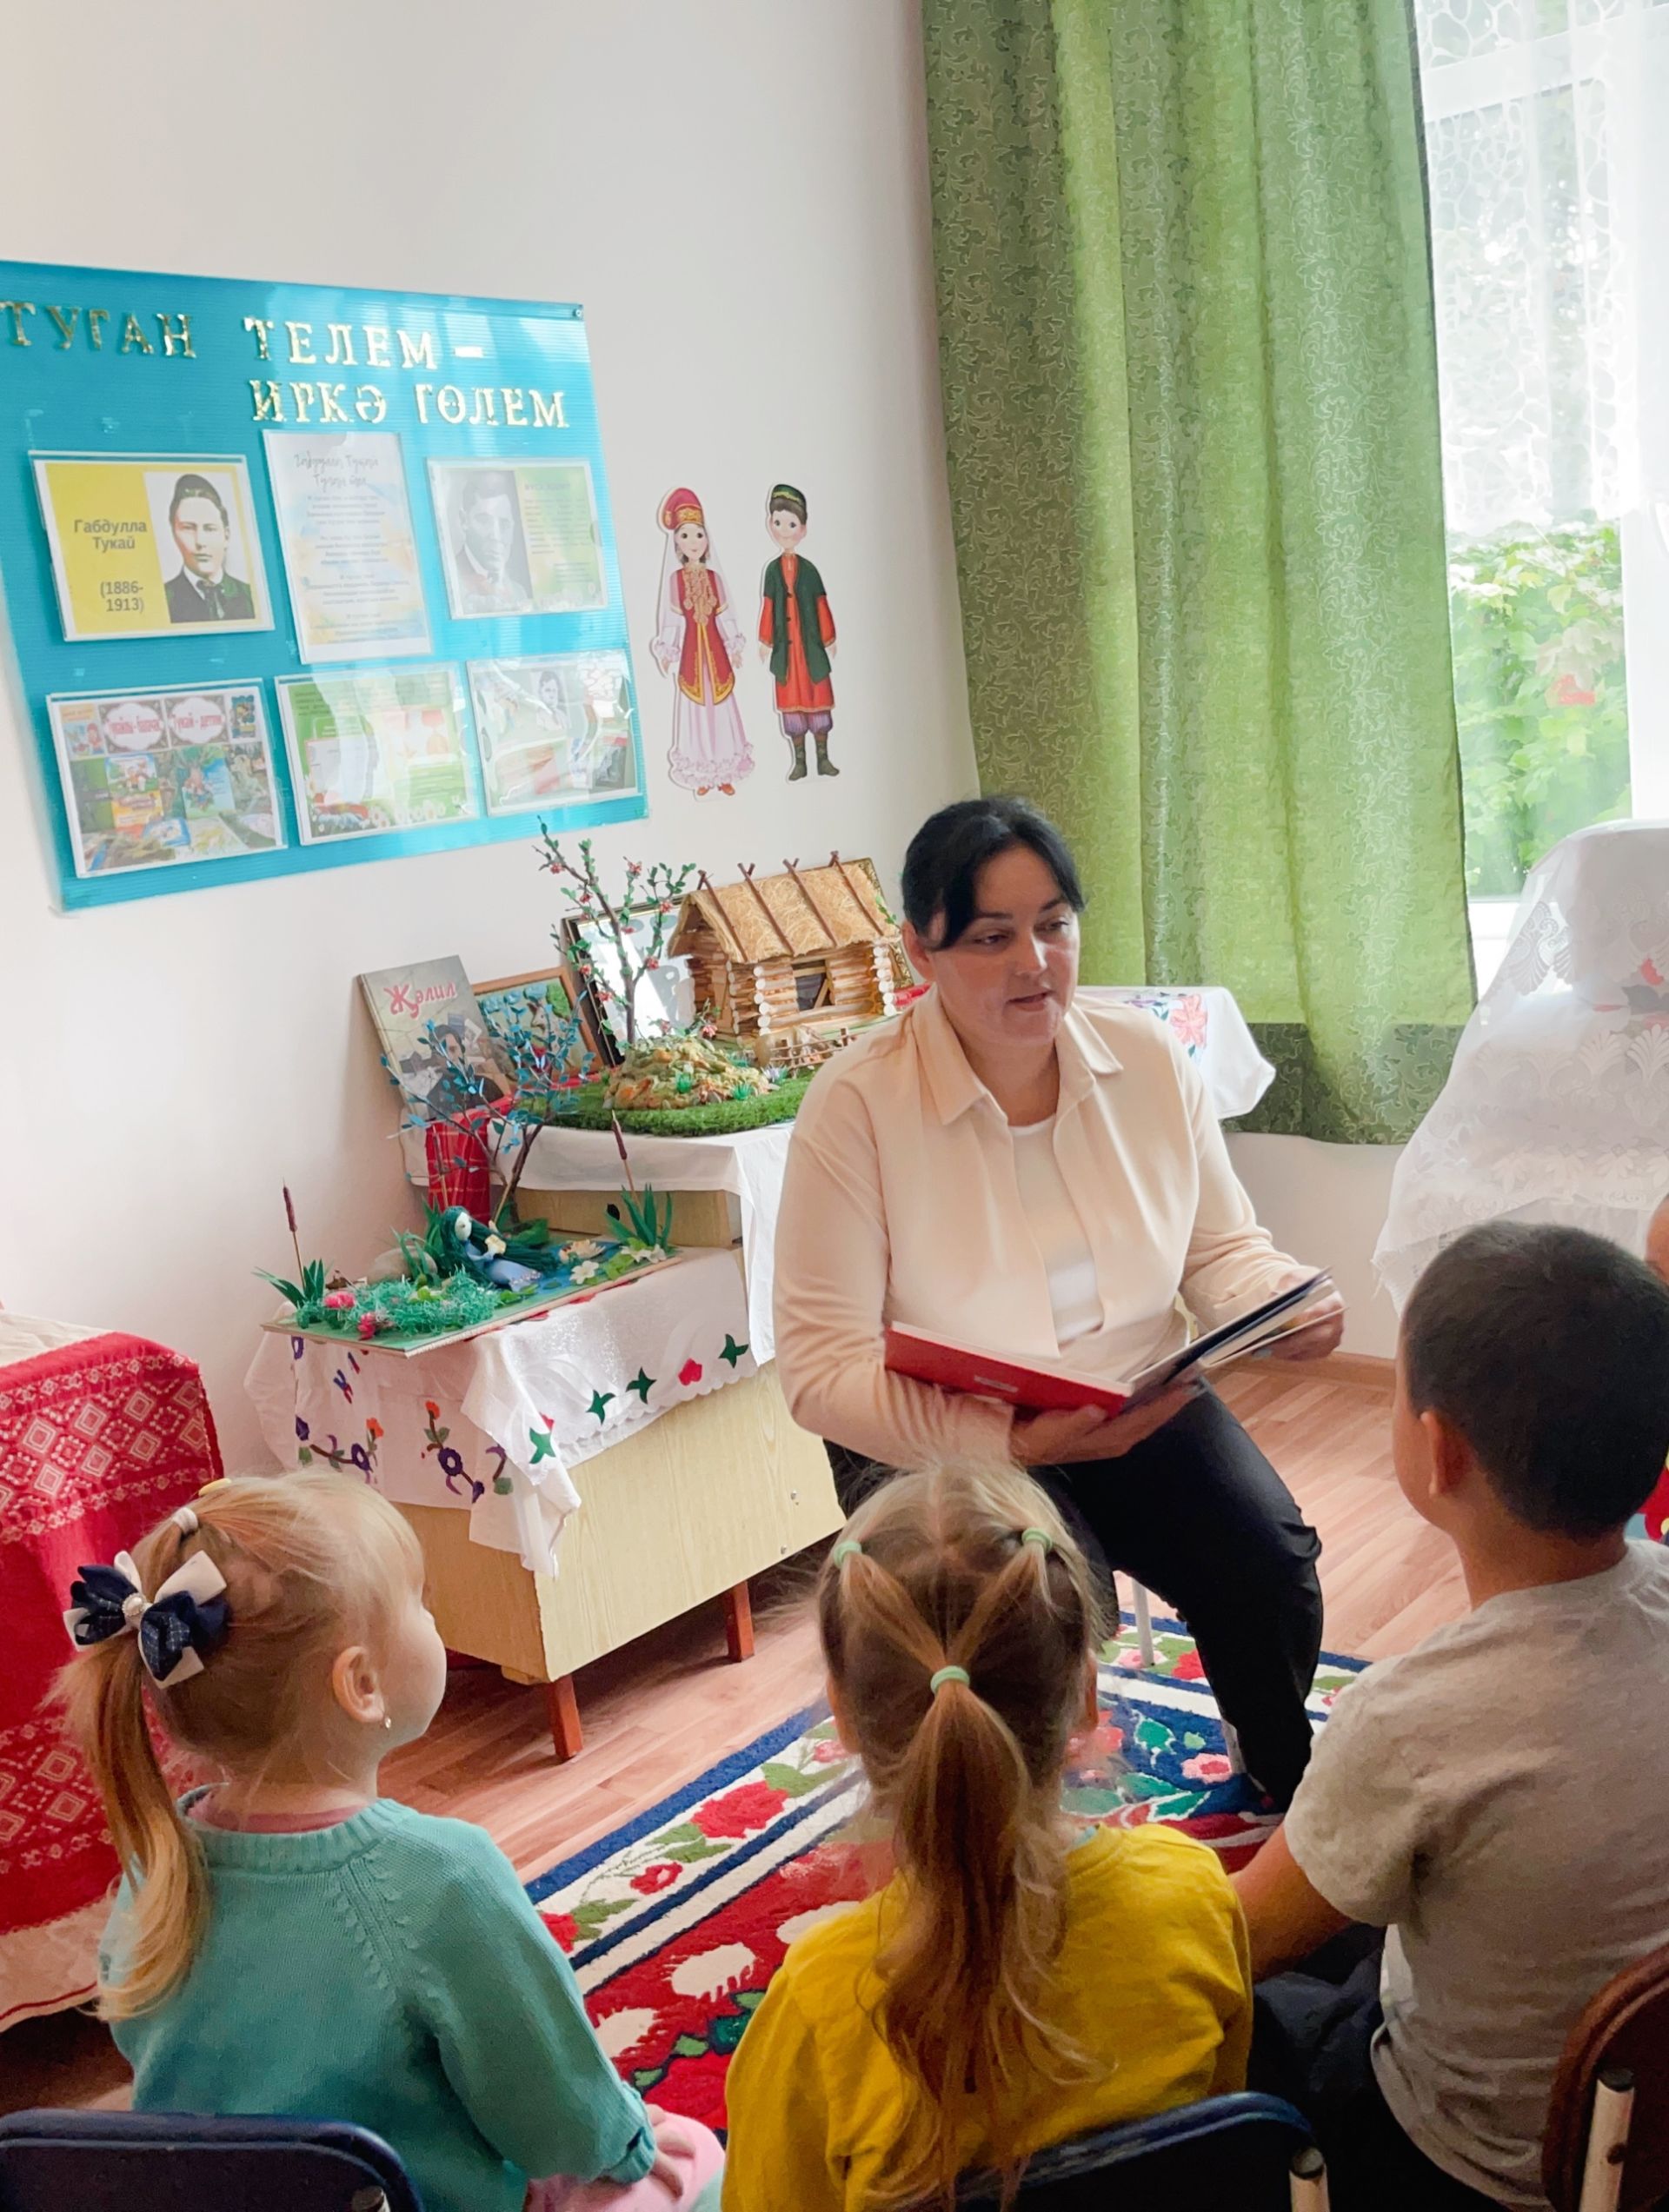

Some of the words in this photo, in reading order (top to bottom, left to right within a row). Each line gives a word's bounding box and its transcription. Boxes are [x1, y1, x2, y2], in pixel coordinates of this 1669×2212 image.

[0, 301, 196, 358] ТУГАН
[244, 317, 437, 369] ТЕЛЕМ
[249, 380, 387, 424] ИРКӘ
[416, 383, 569, 428] ГӨЛЕМ
[74, 519, 147, 535] Габдулла
[92, 536, 135, 553] Тукай
[100, 581, 143, 598] (1886-
[106, 597, 144, 614] 1913)
